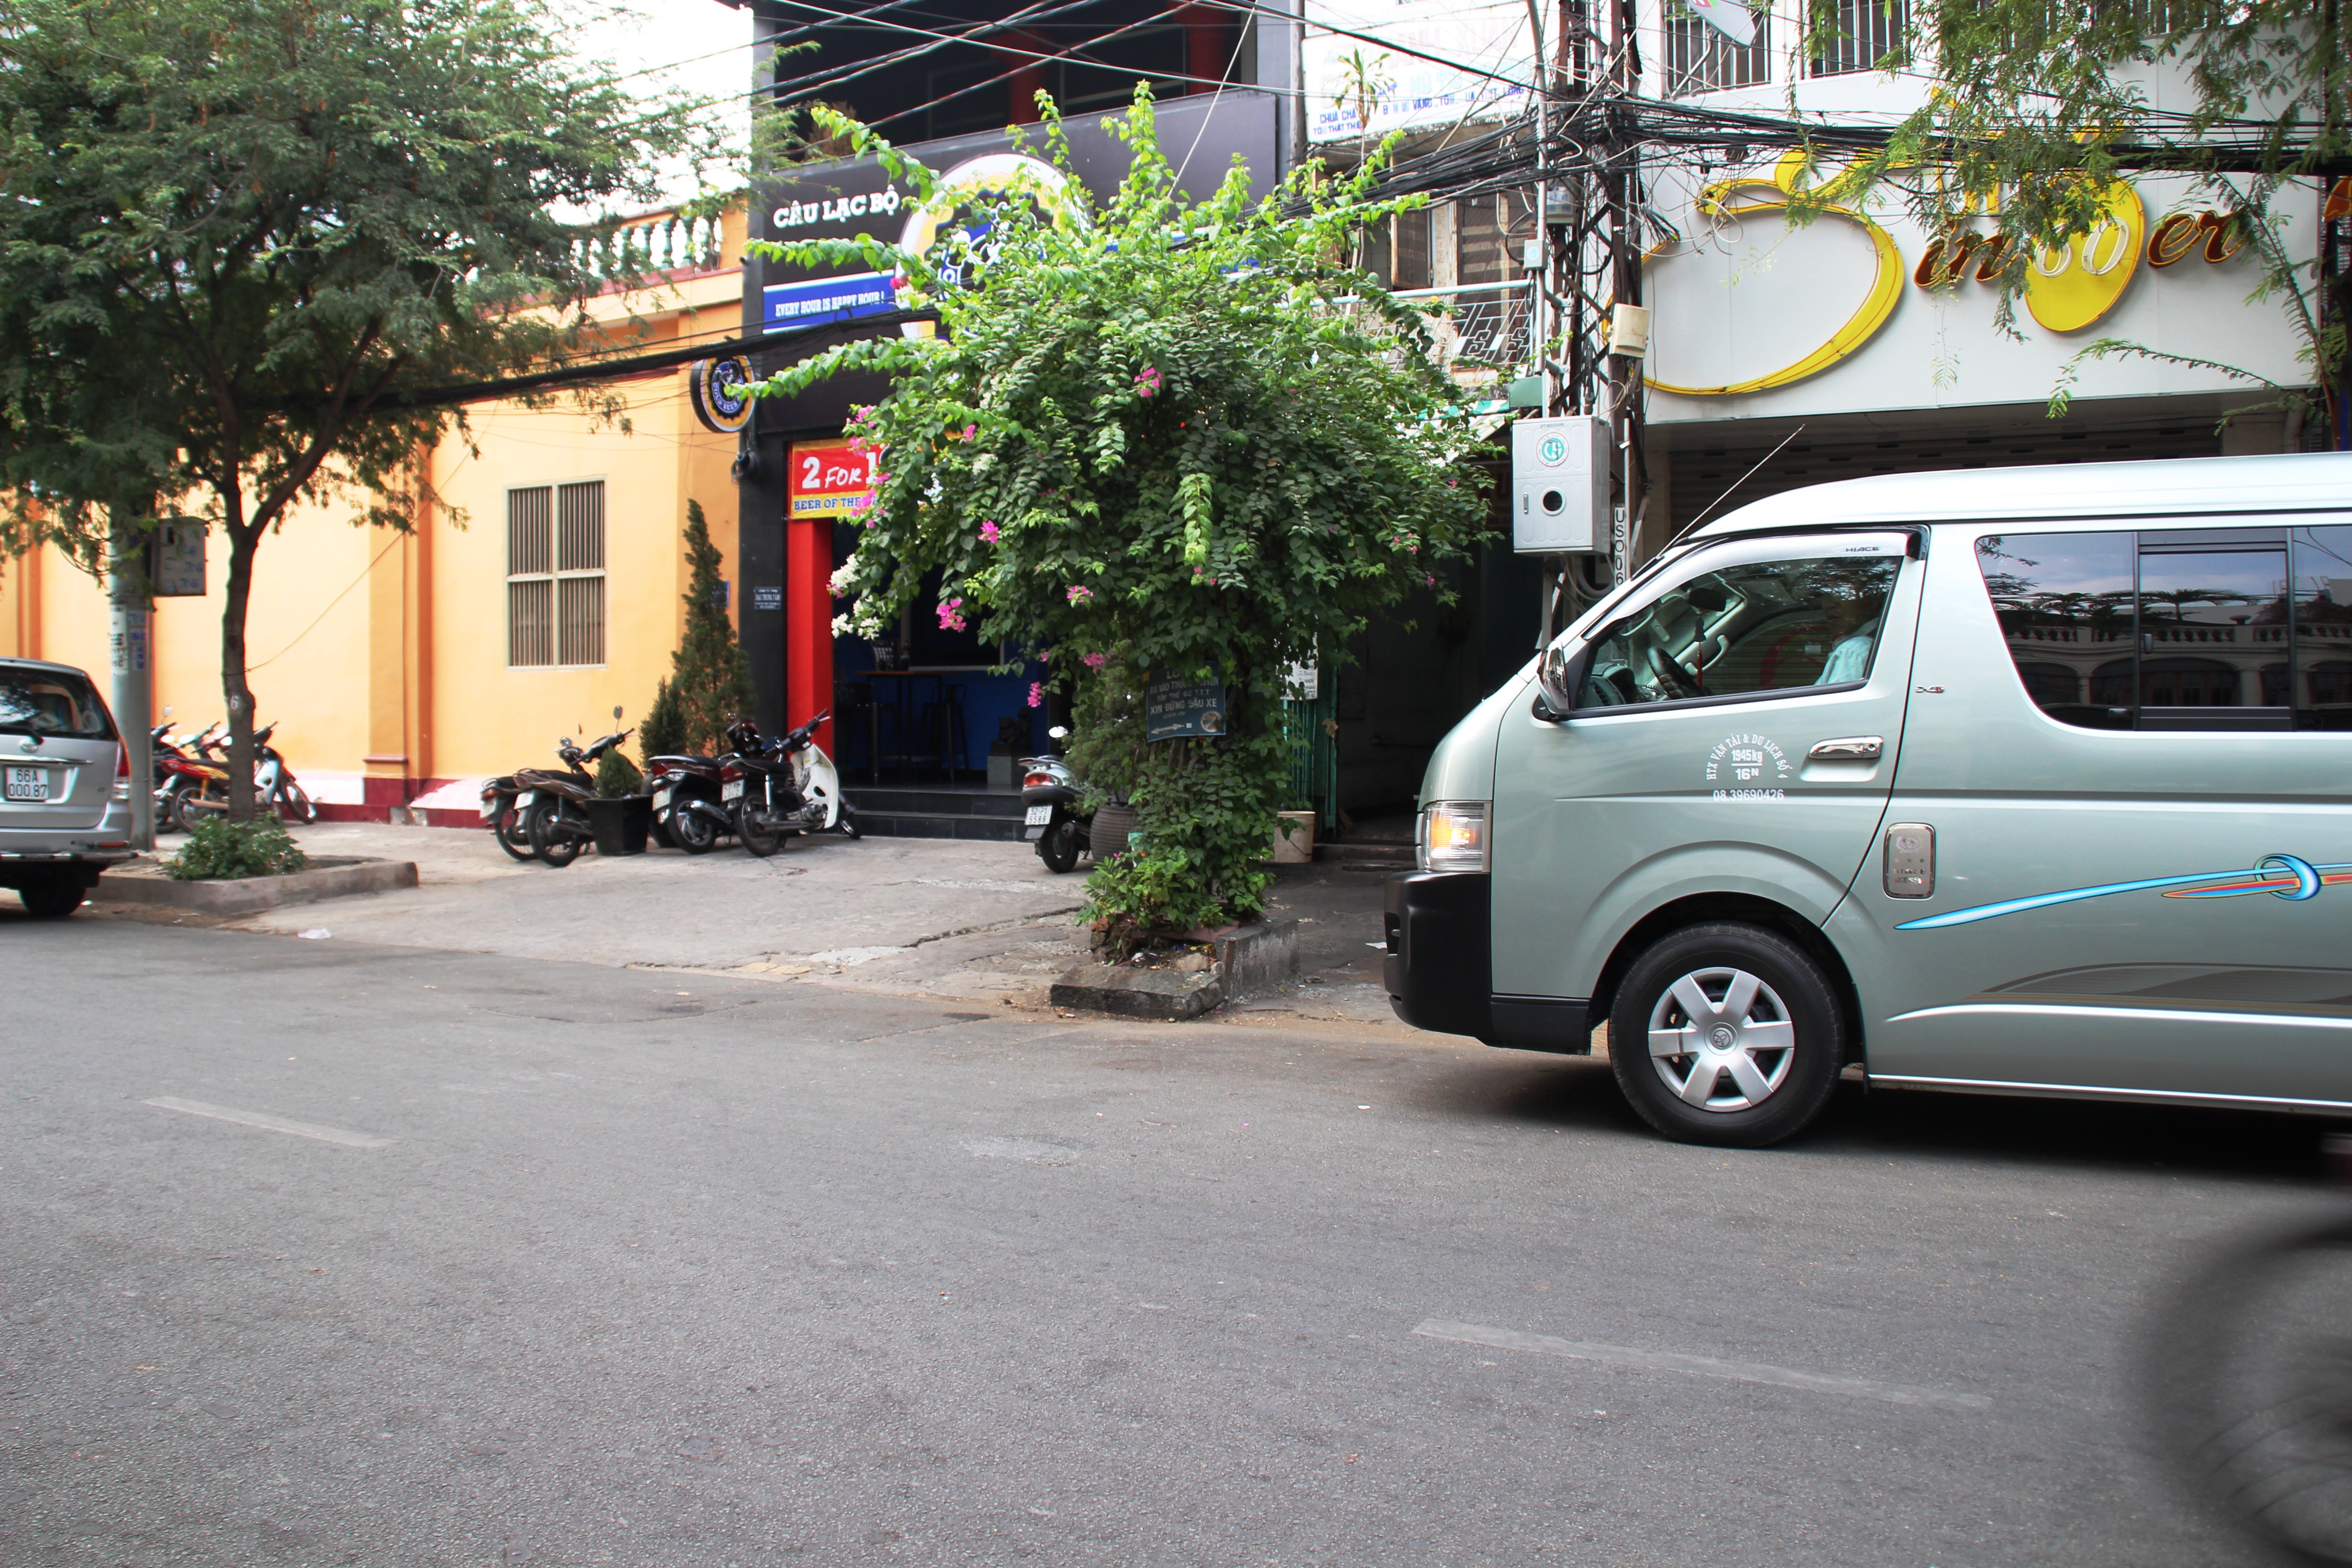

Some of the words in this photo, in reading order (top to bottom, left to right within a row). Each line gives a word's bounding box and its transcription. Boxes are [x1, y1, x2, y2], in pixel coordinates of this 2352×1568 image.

[773, 200, 819, 229] CÂU
[822, 195, 867, 223] LẠC
[869, 184, 900, 216] BỘ
[775, 302, 799, 317] EVERY
[800, 299, 821, 314] HOUR
[822, 298, 831, 311] IS
[802, 456, 820, 489] 2
[825, 466, 862, 488] FOR
[794, 499, 821, 510] BEER
[824, 499, 838, 508] OF
[1150, 705, 1163, 715] XIN
[1206, 698, 1217, 708] XE
[1743, 733, 1749, 744] &
[1751, 734, 1765, 746] DU
[1710, 743, 1728, 761] VẬN
[1763, 739, 1784, 760] LỊCH
[16, 769, 38, 783] 66A
[1706, 761, 1719, 780] HTX
[8, 783, 48, 798] 000.87
[1713, 789, 1784, 802] 08.39690426
